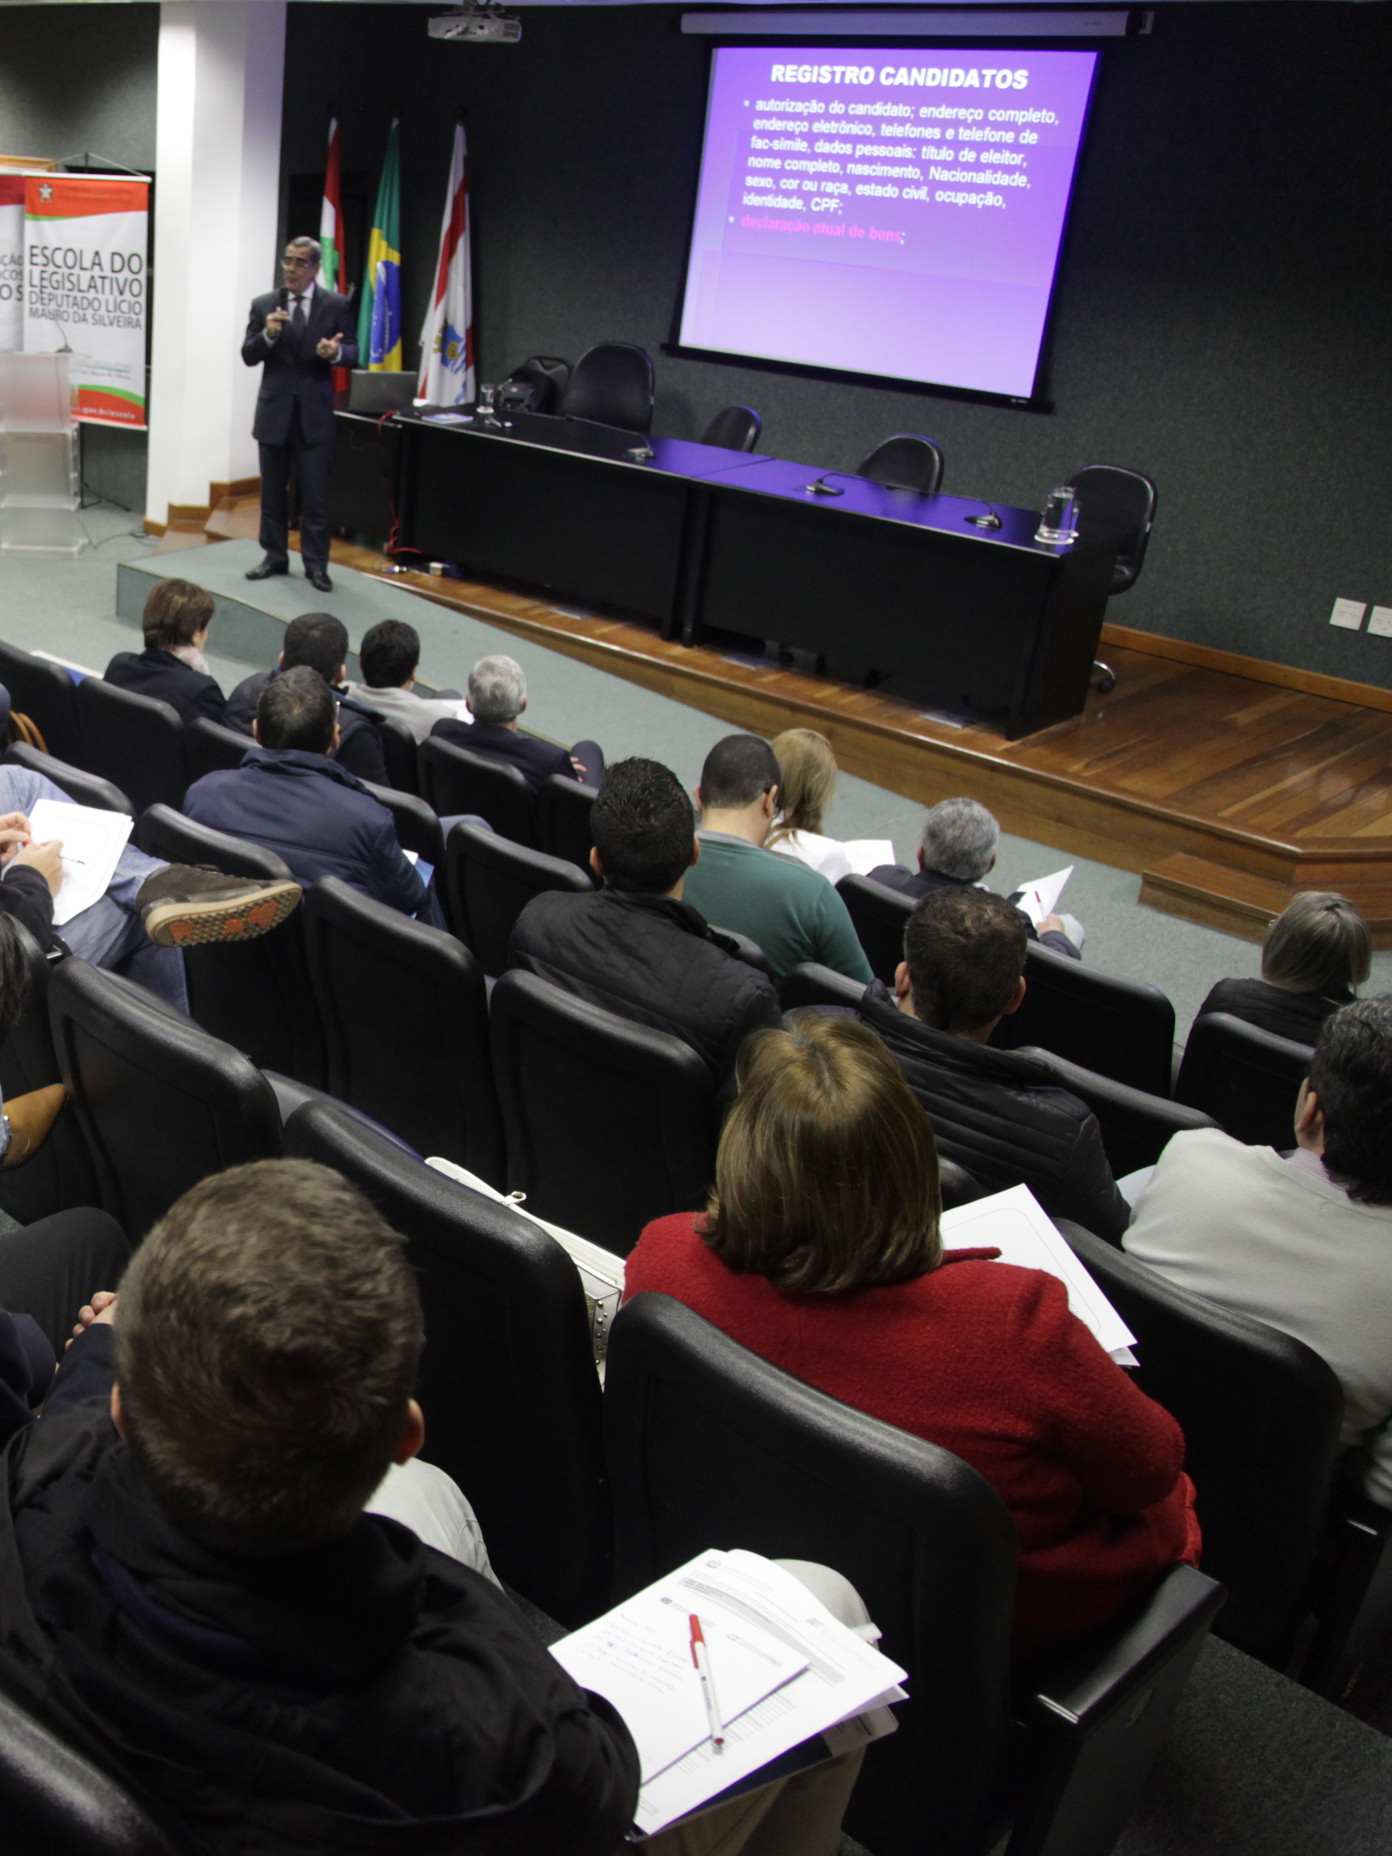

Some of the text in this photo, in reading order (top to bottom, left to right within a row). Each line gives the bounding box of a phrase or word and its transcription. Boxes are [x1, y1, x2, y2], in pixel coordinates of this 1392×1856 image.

[771, 64, 1028, 90] REGISTRO CANDIDATOS
[756, 98, 825, 116] autorização
[829, 101, 845, 115] do
[919, 103, 984, 123] endereço
[987, 106, 1059, 126] completo,
[753, 118, 808, 134] endereço
[880, 124, 941, 139] telefones
[945, 130, 954, 140] e
[958, 126, 1014, 143] telefone
[1019, 130, 1038, 144] de
[814, 139, 852, 155] dados
[855, 144, 917, 160] pessoais:
[958, 148, 976, 163] de
[980, 148, 1027, 168] eleitor,
[748, 157, 1031, 189] nome completo, nascimento, Nacionalidade,
[743, 193, 843, 215] identidade, CPF;
[745, 176, 1006, 210] sexo, cor ou raça, estado civil, ocupação,
[741, 215, 810, 234] declaração
[813, 219, 845, 236] atual
[849, 225, 865, 239] de
[30, 245, 143, 274] ESCOLA DO
[29, 270, 143, 297] LEGISLATIVO
[29, 291, 142, 315] DEPUTADO LÍCIO
[29, 307, 142, 330] MAURO DA SILVEIRA
